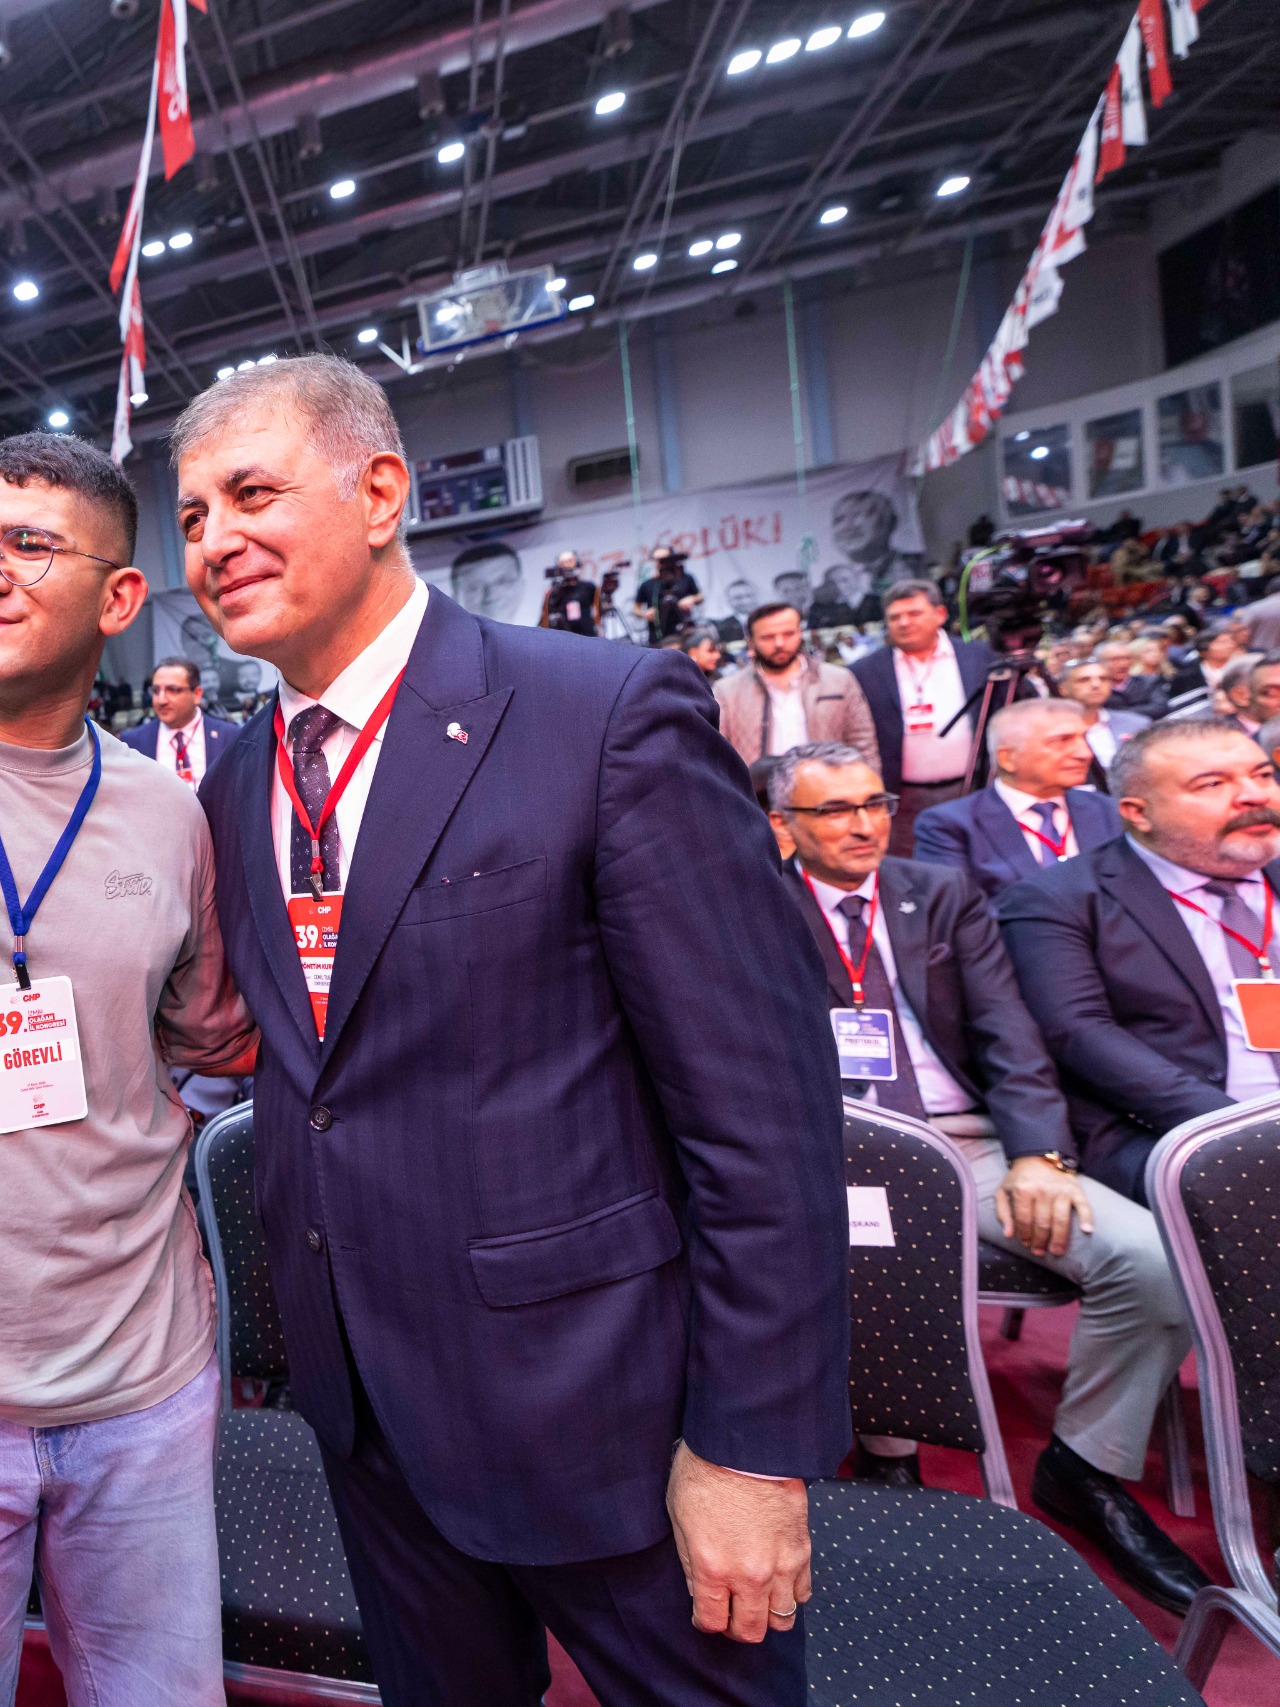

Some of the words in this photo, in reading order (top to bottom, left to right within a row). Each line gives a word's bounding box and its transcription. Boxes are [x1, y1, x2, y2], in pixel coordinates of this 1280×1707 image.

[318, 906, 331, 914] CHP
[295, 925, 322, 948] 39.
[23, 993, 41, 1002] CHP
[4, 1041, 63, 1070] GÖREVLİ
